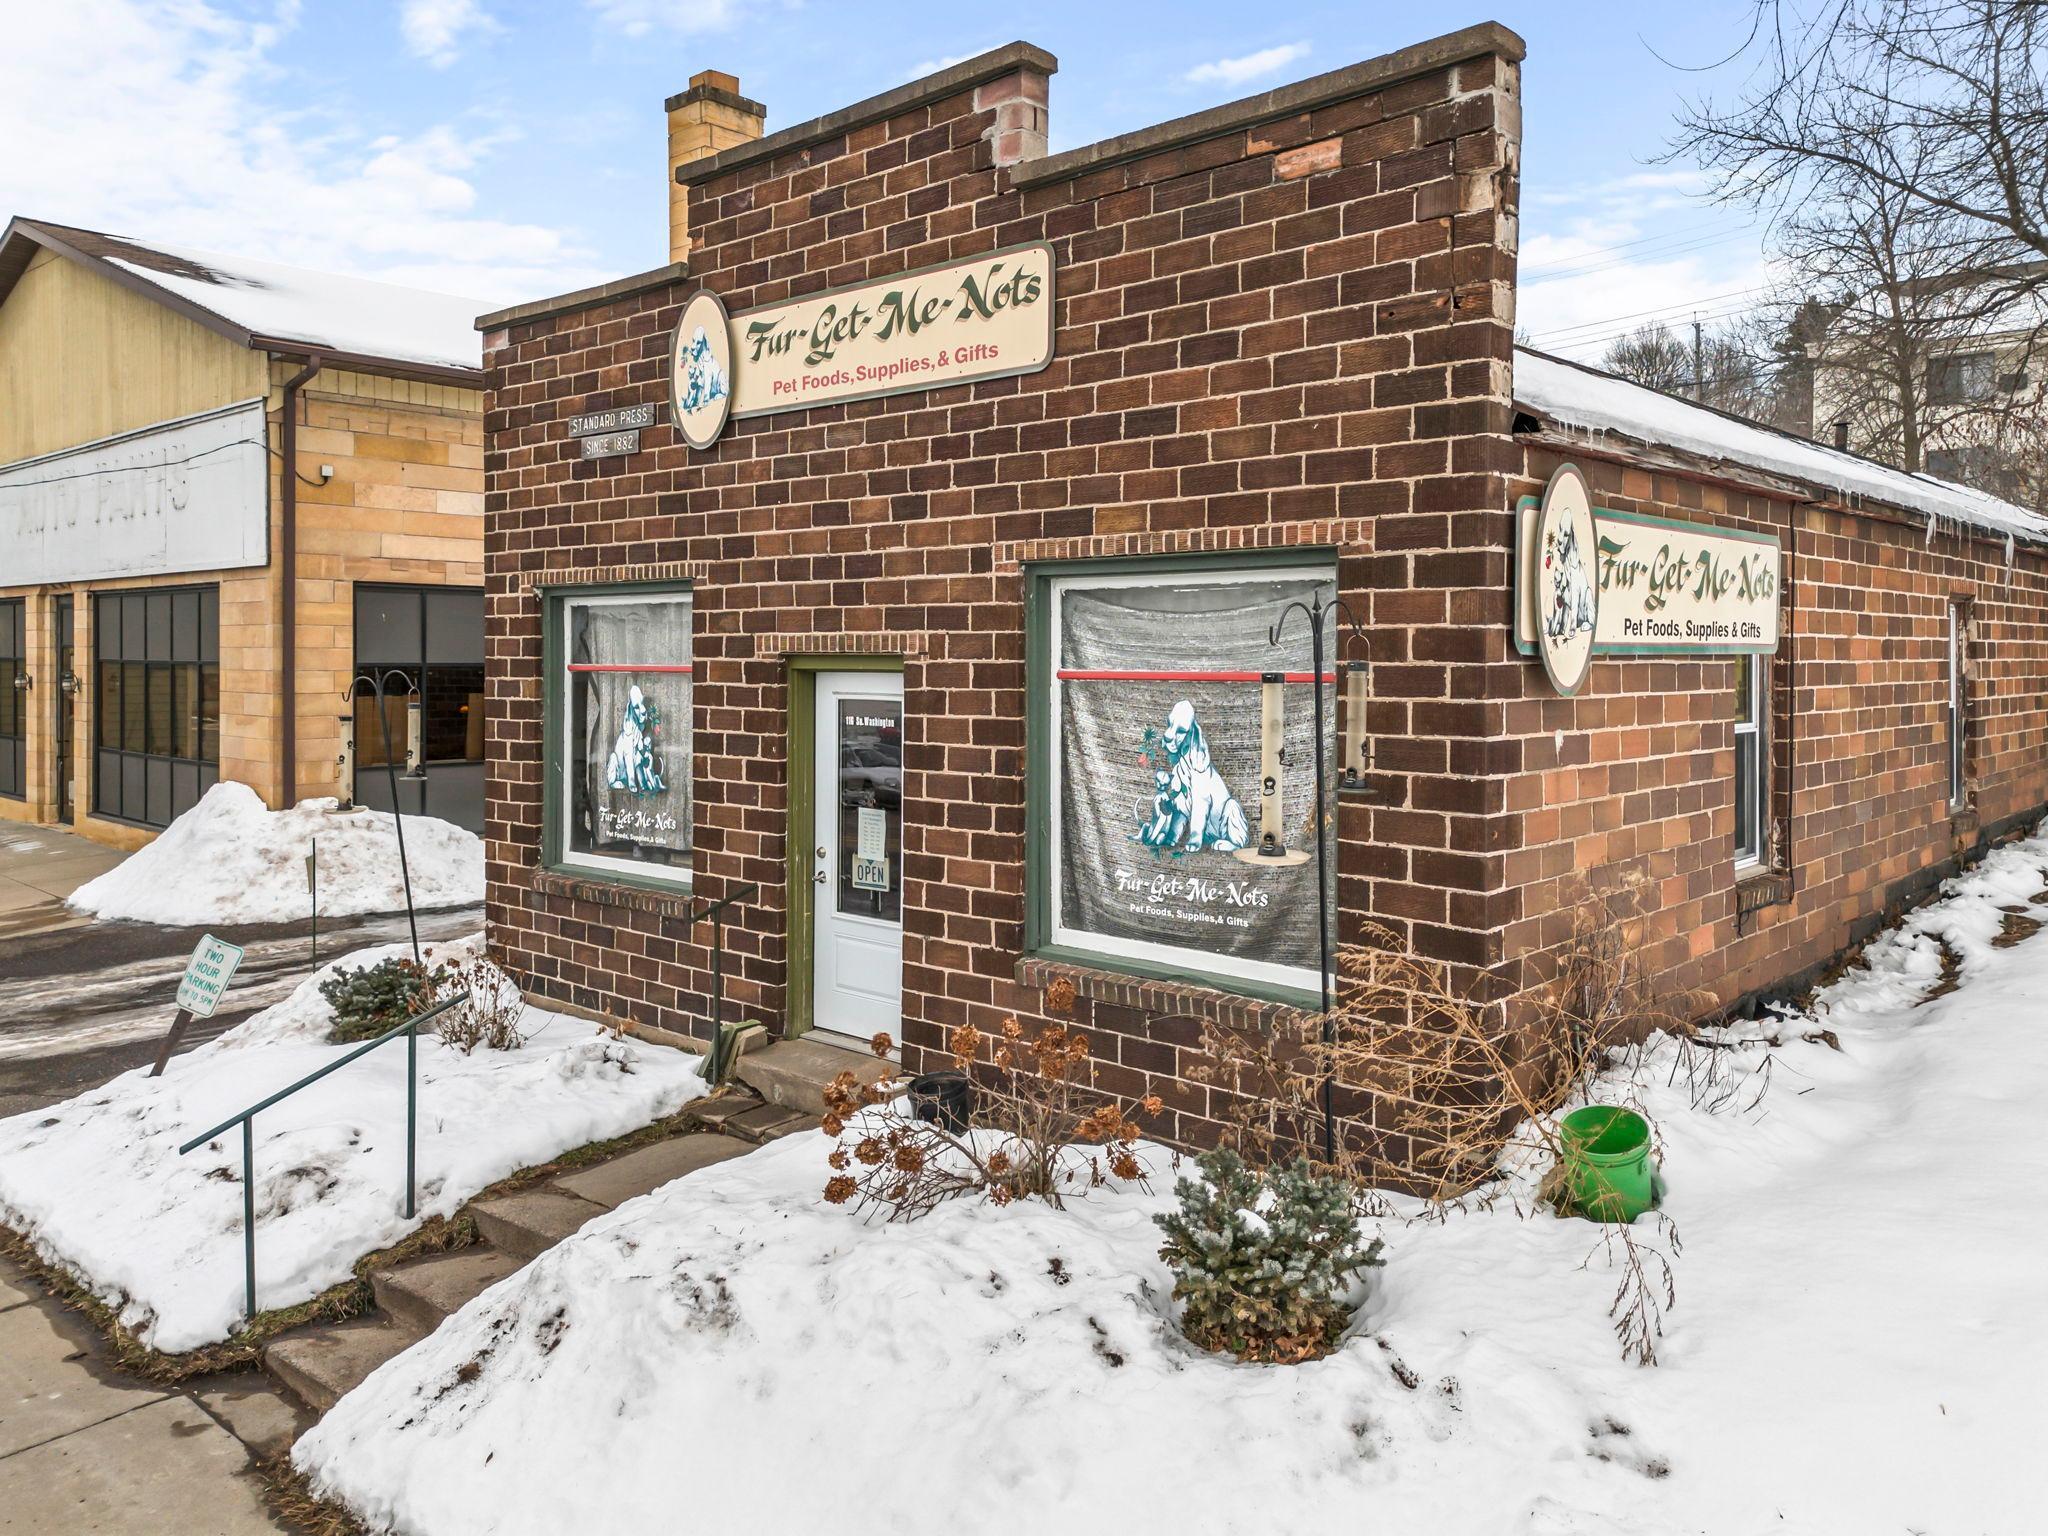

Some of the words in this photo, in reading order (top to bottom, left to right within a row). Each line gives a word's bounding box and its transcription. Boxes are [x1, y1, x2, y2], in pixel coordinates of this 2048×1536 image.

[773, 378, 797, 395] Pet
[802, 370, 854, 390] Foods,
[856, 357, 935, 381] Supplies,
[937, 350, 950, 367] &
[954, 343, 999, 364] Gifts
[573, 413, 616, 432] STANDARD
[620, 407, 648, 424] PRESS
[586, 438, 609, 455] SINCE
[614, 435, 633, 451] 1882
[1624, 618, 1643, 636] Pet
[1646, 618, 1682, 639] Foods,
[1686, 619, 1729, 641] Supplies
[1732, 622, 1738, 637] &
[1740, 622, 1761, 638] Gifts
[857, 865, 884, 883] OPEN
[1130, 903, 1144, 913] Pet
[1146, 905, 1174, 918] Foods,
[1217, 915, 1224, 924] &
[1226, 916, 1249, 928] Gifts
[204, 948, 225, 964] TWO
[195, 961, 220, 978] HOUR
[185, 971, 220, 995] PARKING
[191, 991, 199, 1001] TO
